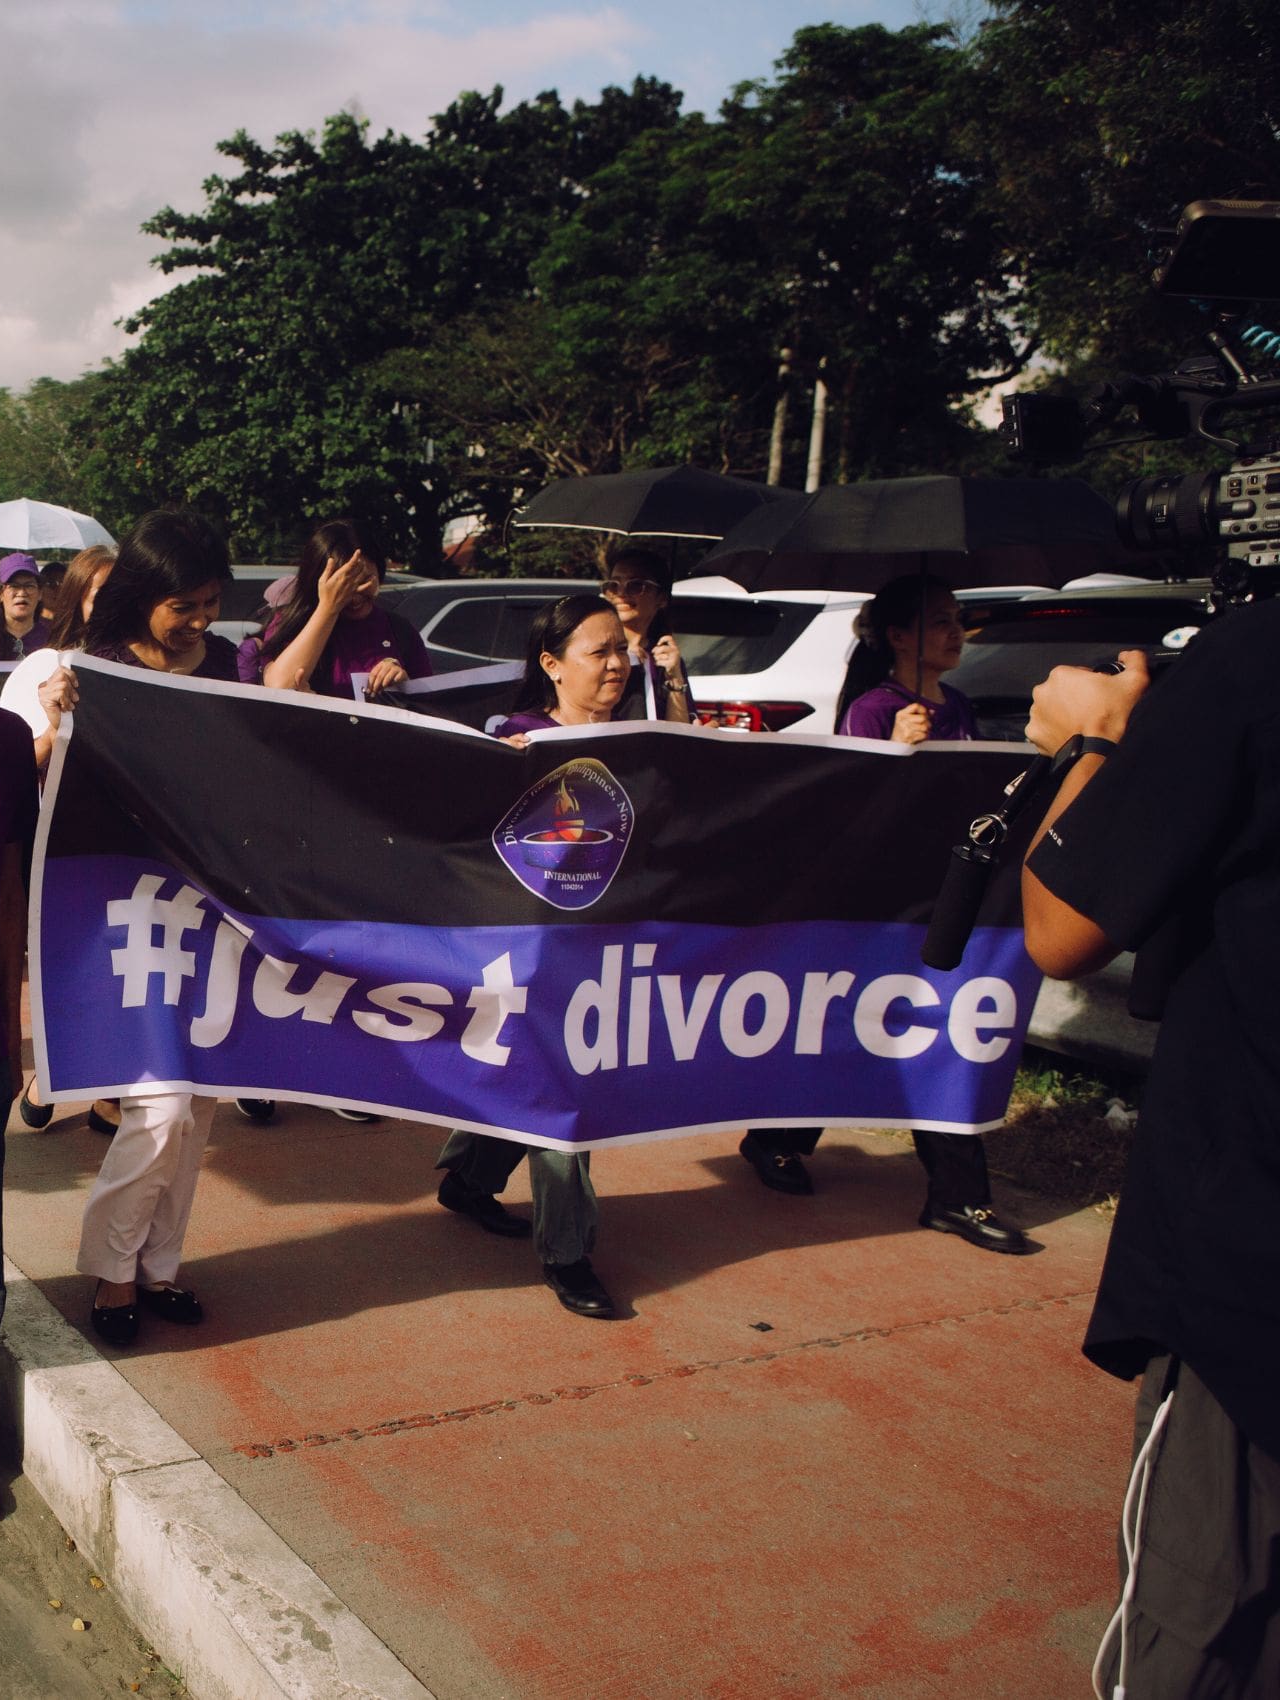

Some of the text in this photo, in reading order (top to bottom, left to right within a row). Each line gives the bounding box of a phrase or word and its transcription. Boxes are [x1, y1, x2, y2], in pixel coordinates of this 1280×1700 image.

[543, 870, 602, 882] INTERNATIONAL
[106, 873, 1018, 1076] #just divorce
